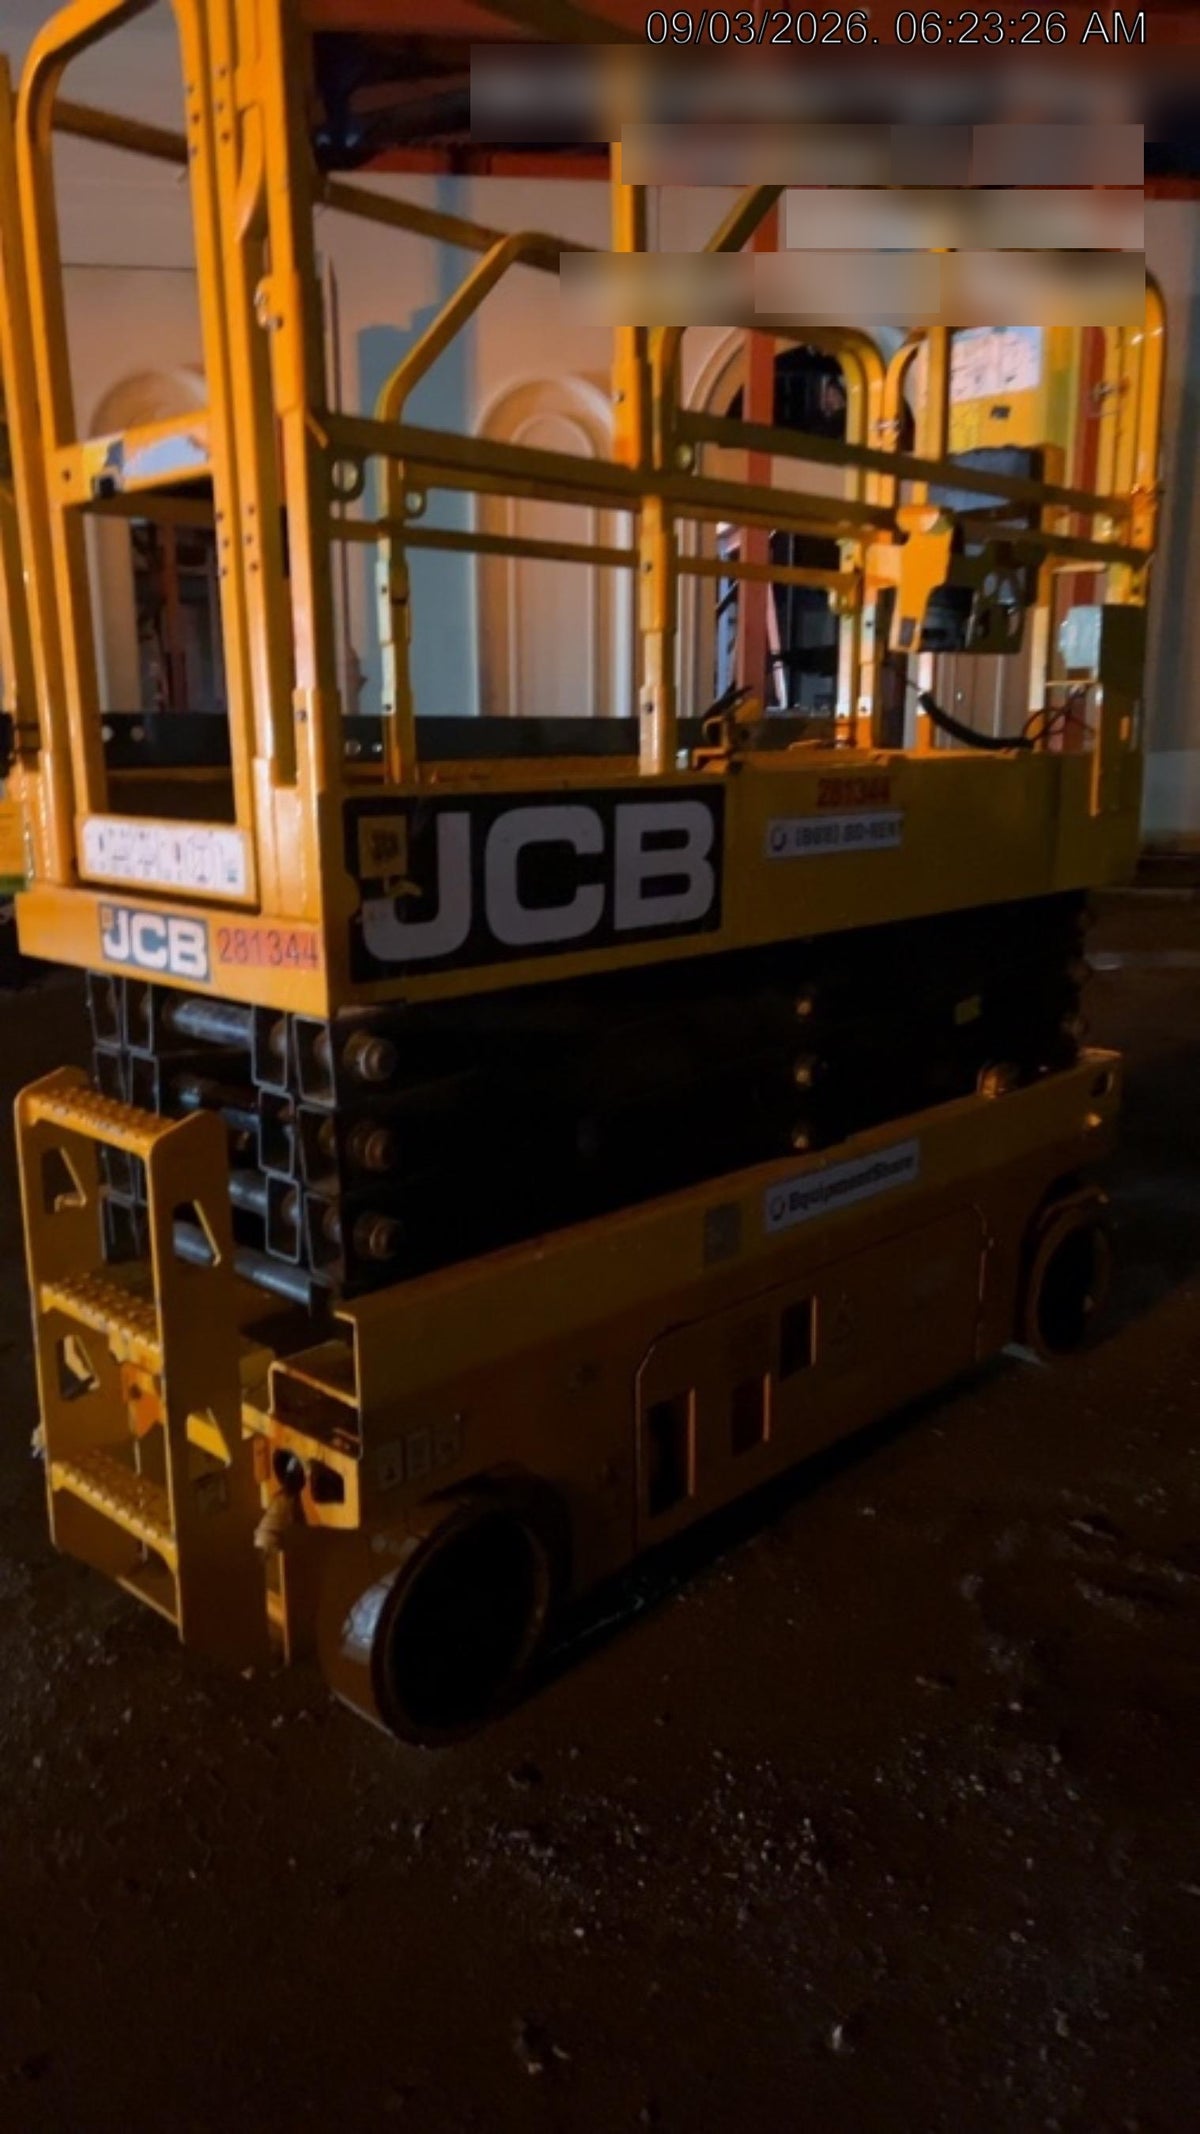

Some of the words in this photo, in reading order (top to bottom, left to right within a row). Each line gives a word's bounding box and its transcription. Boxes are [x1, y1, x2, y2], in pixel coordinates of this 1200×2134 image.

[361, 800, 715, 962] JCB
[103, 908, 208, 979] JCB
[217, 928, 319, 968] 281344
[789, 1155, 914, 1213] EquipmentShare
